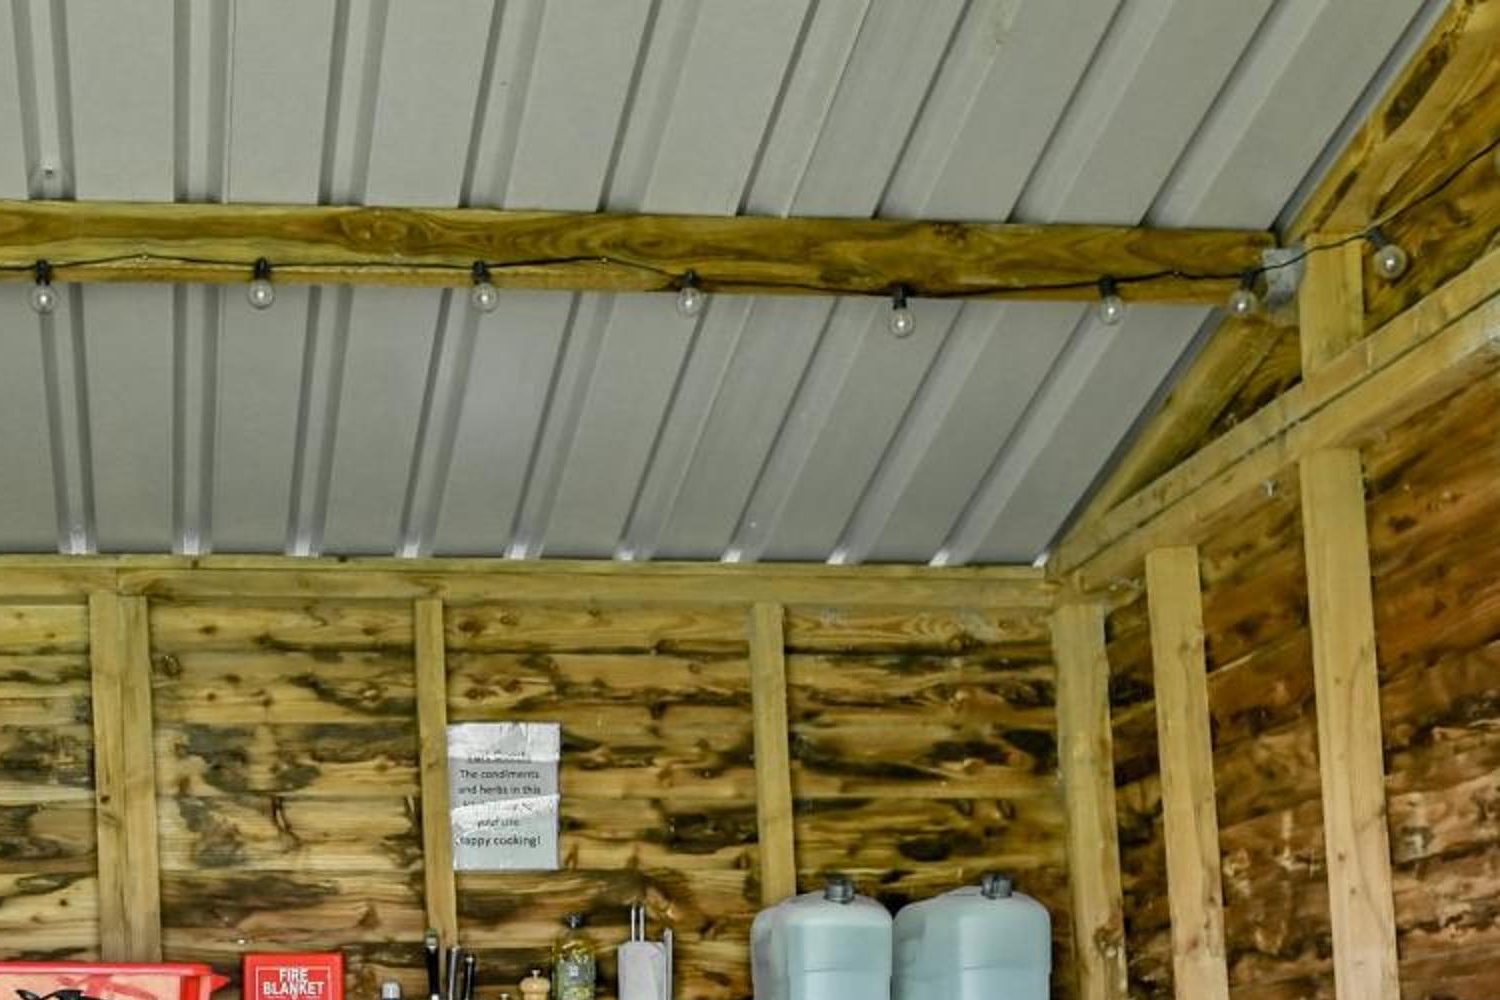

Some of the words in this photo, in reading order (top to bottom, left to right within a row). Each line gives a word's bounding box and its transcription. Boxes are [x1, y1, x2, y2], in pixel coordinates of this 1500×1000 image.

[459, 769, 478, 780] The
[480, 769, 540, 780] condiments
[458, 784, 477, 795] and
[479, 784, 508, 795] herbs
[510, 785, 521, 795] in
[522, 784, 542, 795] this
[493, 834, 542, 848] cooking!
[279, 967, 309, 982] FIRE
[263, 981, 325, 995] BLANKET
